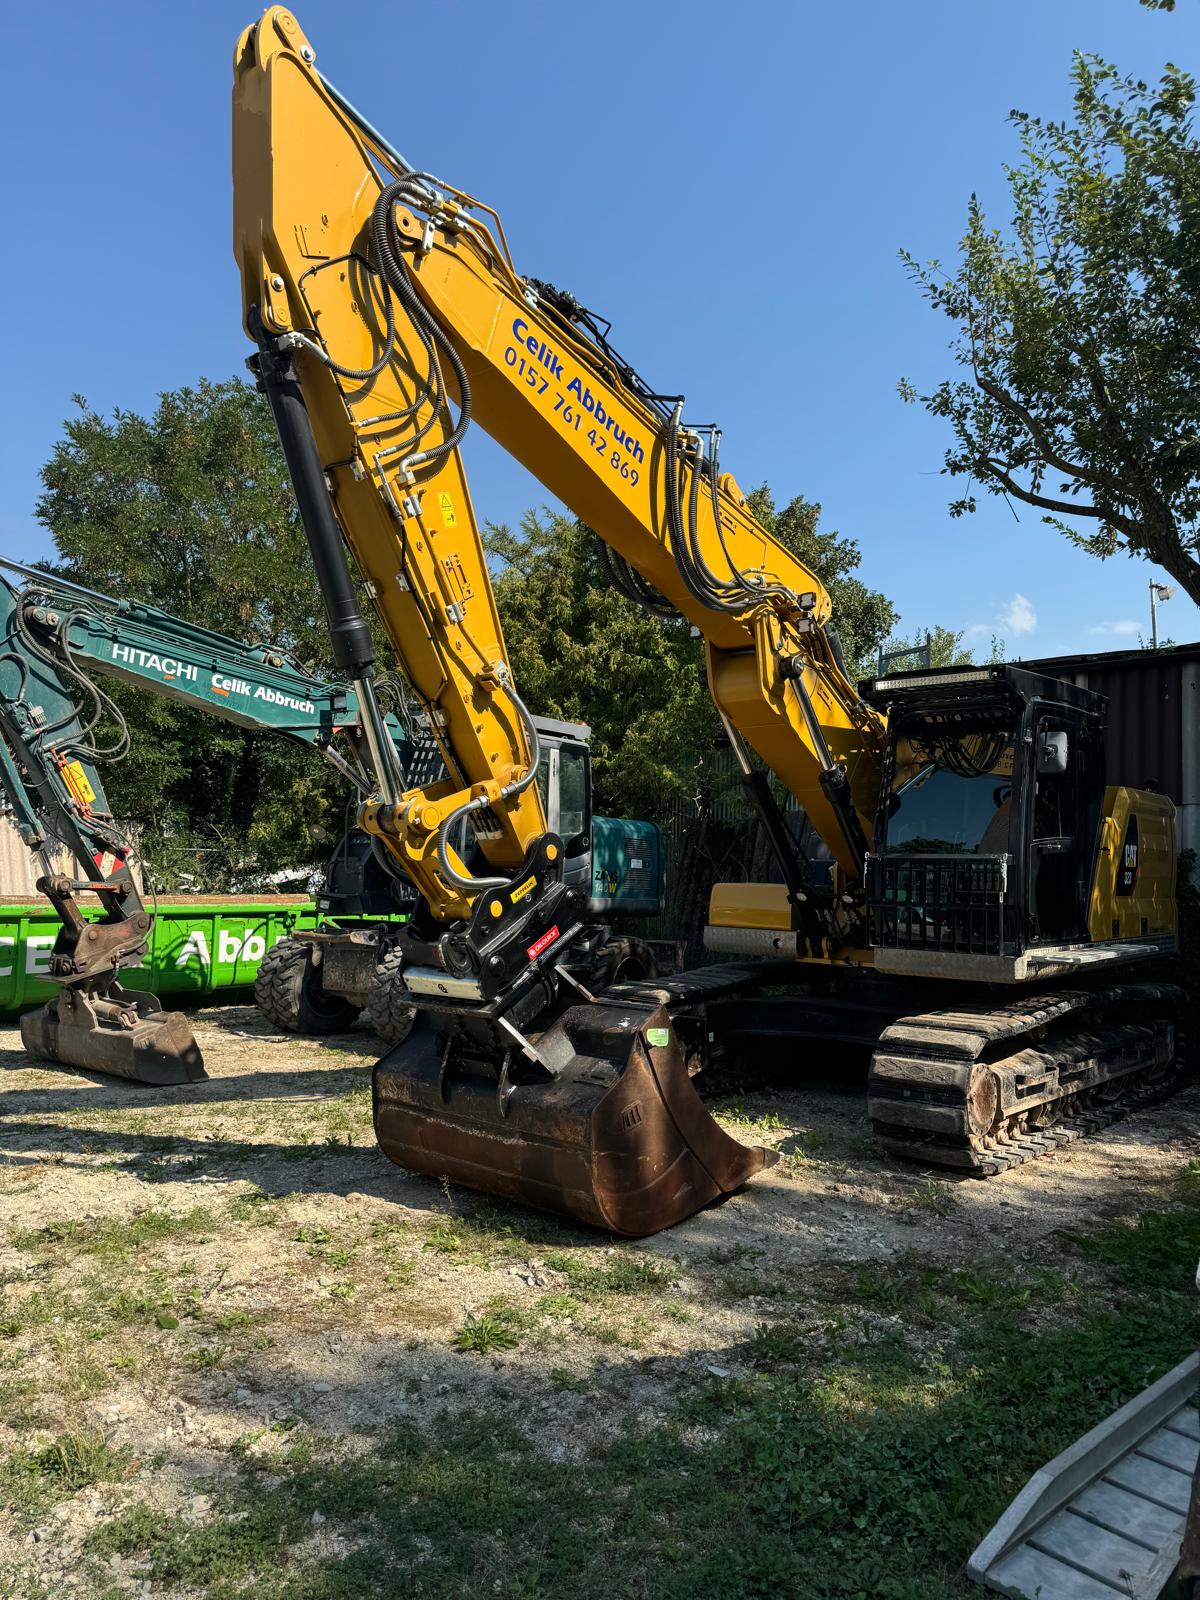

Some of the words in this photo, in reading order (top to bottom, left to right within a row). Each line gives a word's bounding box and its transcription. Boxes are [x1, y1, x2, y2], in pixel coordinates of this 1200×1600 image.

[512, 318, 565, 382] Celik
[566, 376, 645, 464] Abbruch
[504, 346, 549, 395] 0157
[553, 392, 582, 431] 761
[587, 429, 607, 457] 42
[610, 451, 639, 488] 869
[111, 643, 199, 682] HITACHI
[211, 673, 252, 696] Celik
[253, 685, 315, 715] Abbruch
[1124, 844, 1138, 868] CAT
[175, 928, 287, 966] Abb
